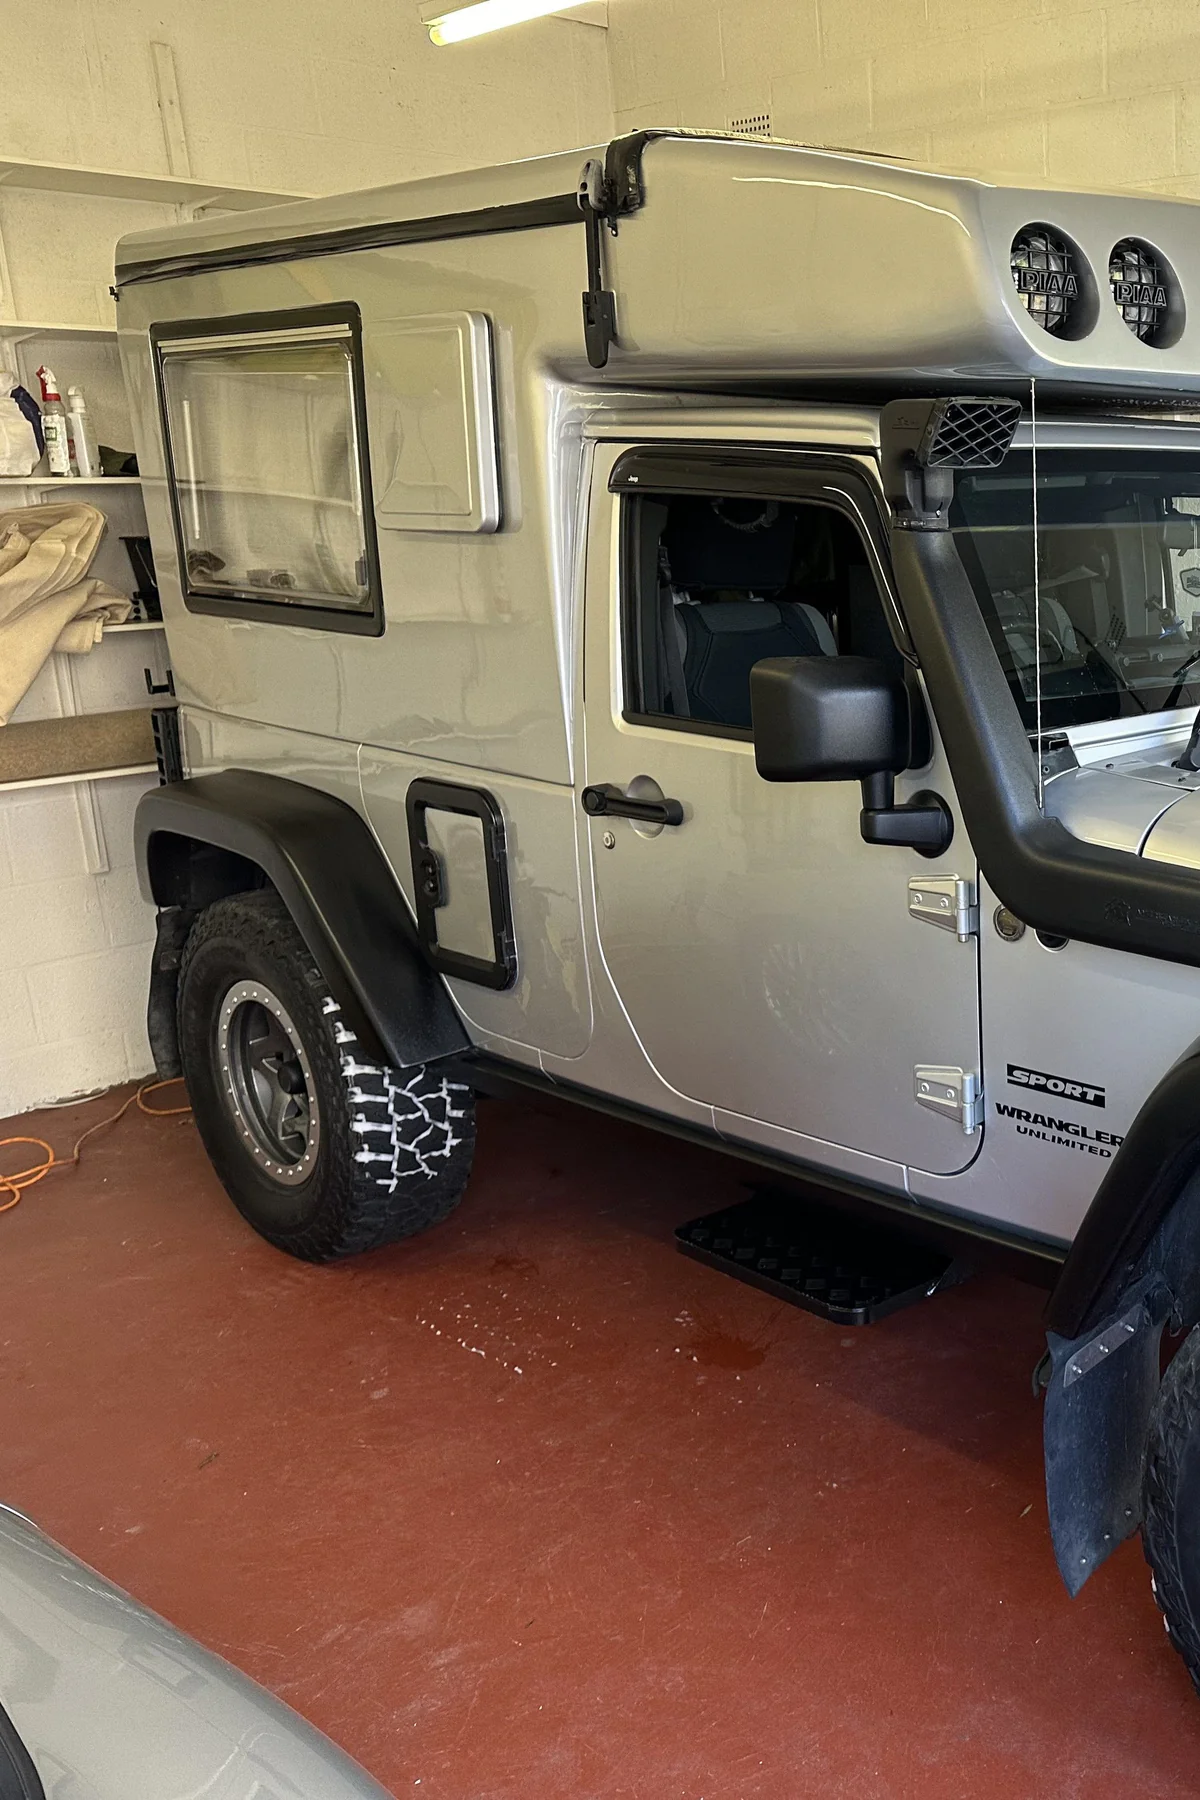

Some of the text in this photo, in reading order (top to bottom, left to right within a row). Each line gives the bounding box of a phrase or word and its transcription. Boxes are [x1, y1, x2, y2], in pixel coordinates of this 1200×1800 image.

[1020, 269, 1078, 297] PIAA
[1116, 282, 1167, 307] PIAA
[1010, 1069, 1105, 1102] SPORT
[995, 1102, 1125, 1148] WRANGLER
[1016, 1124, 1112, 1158] UNLIMITED
